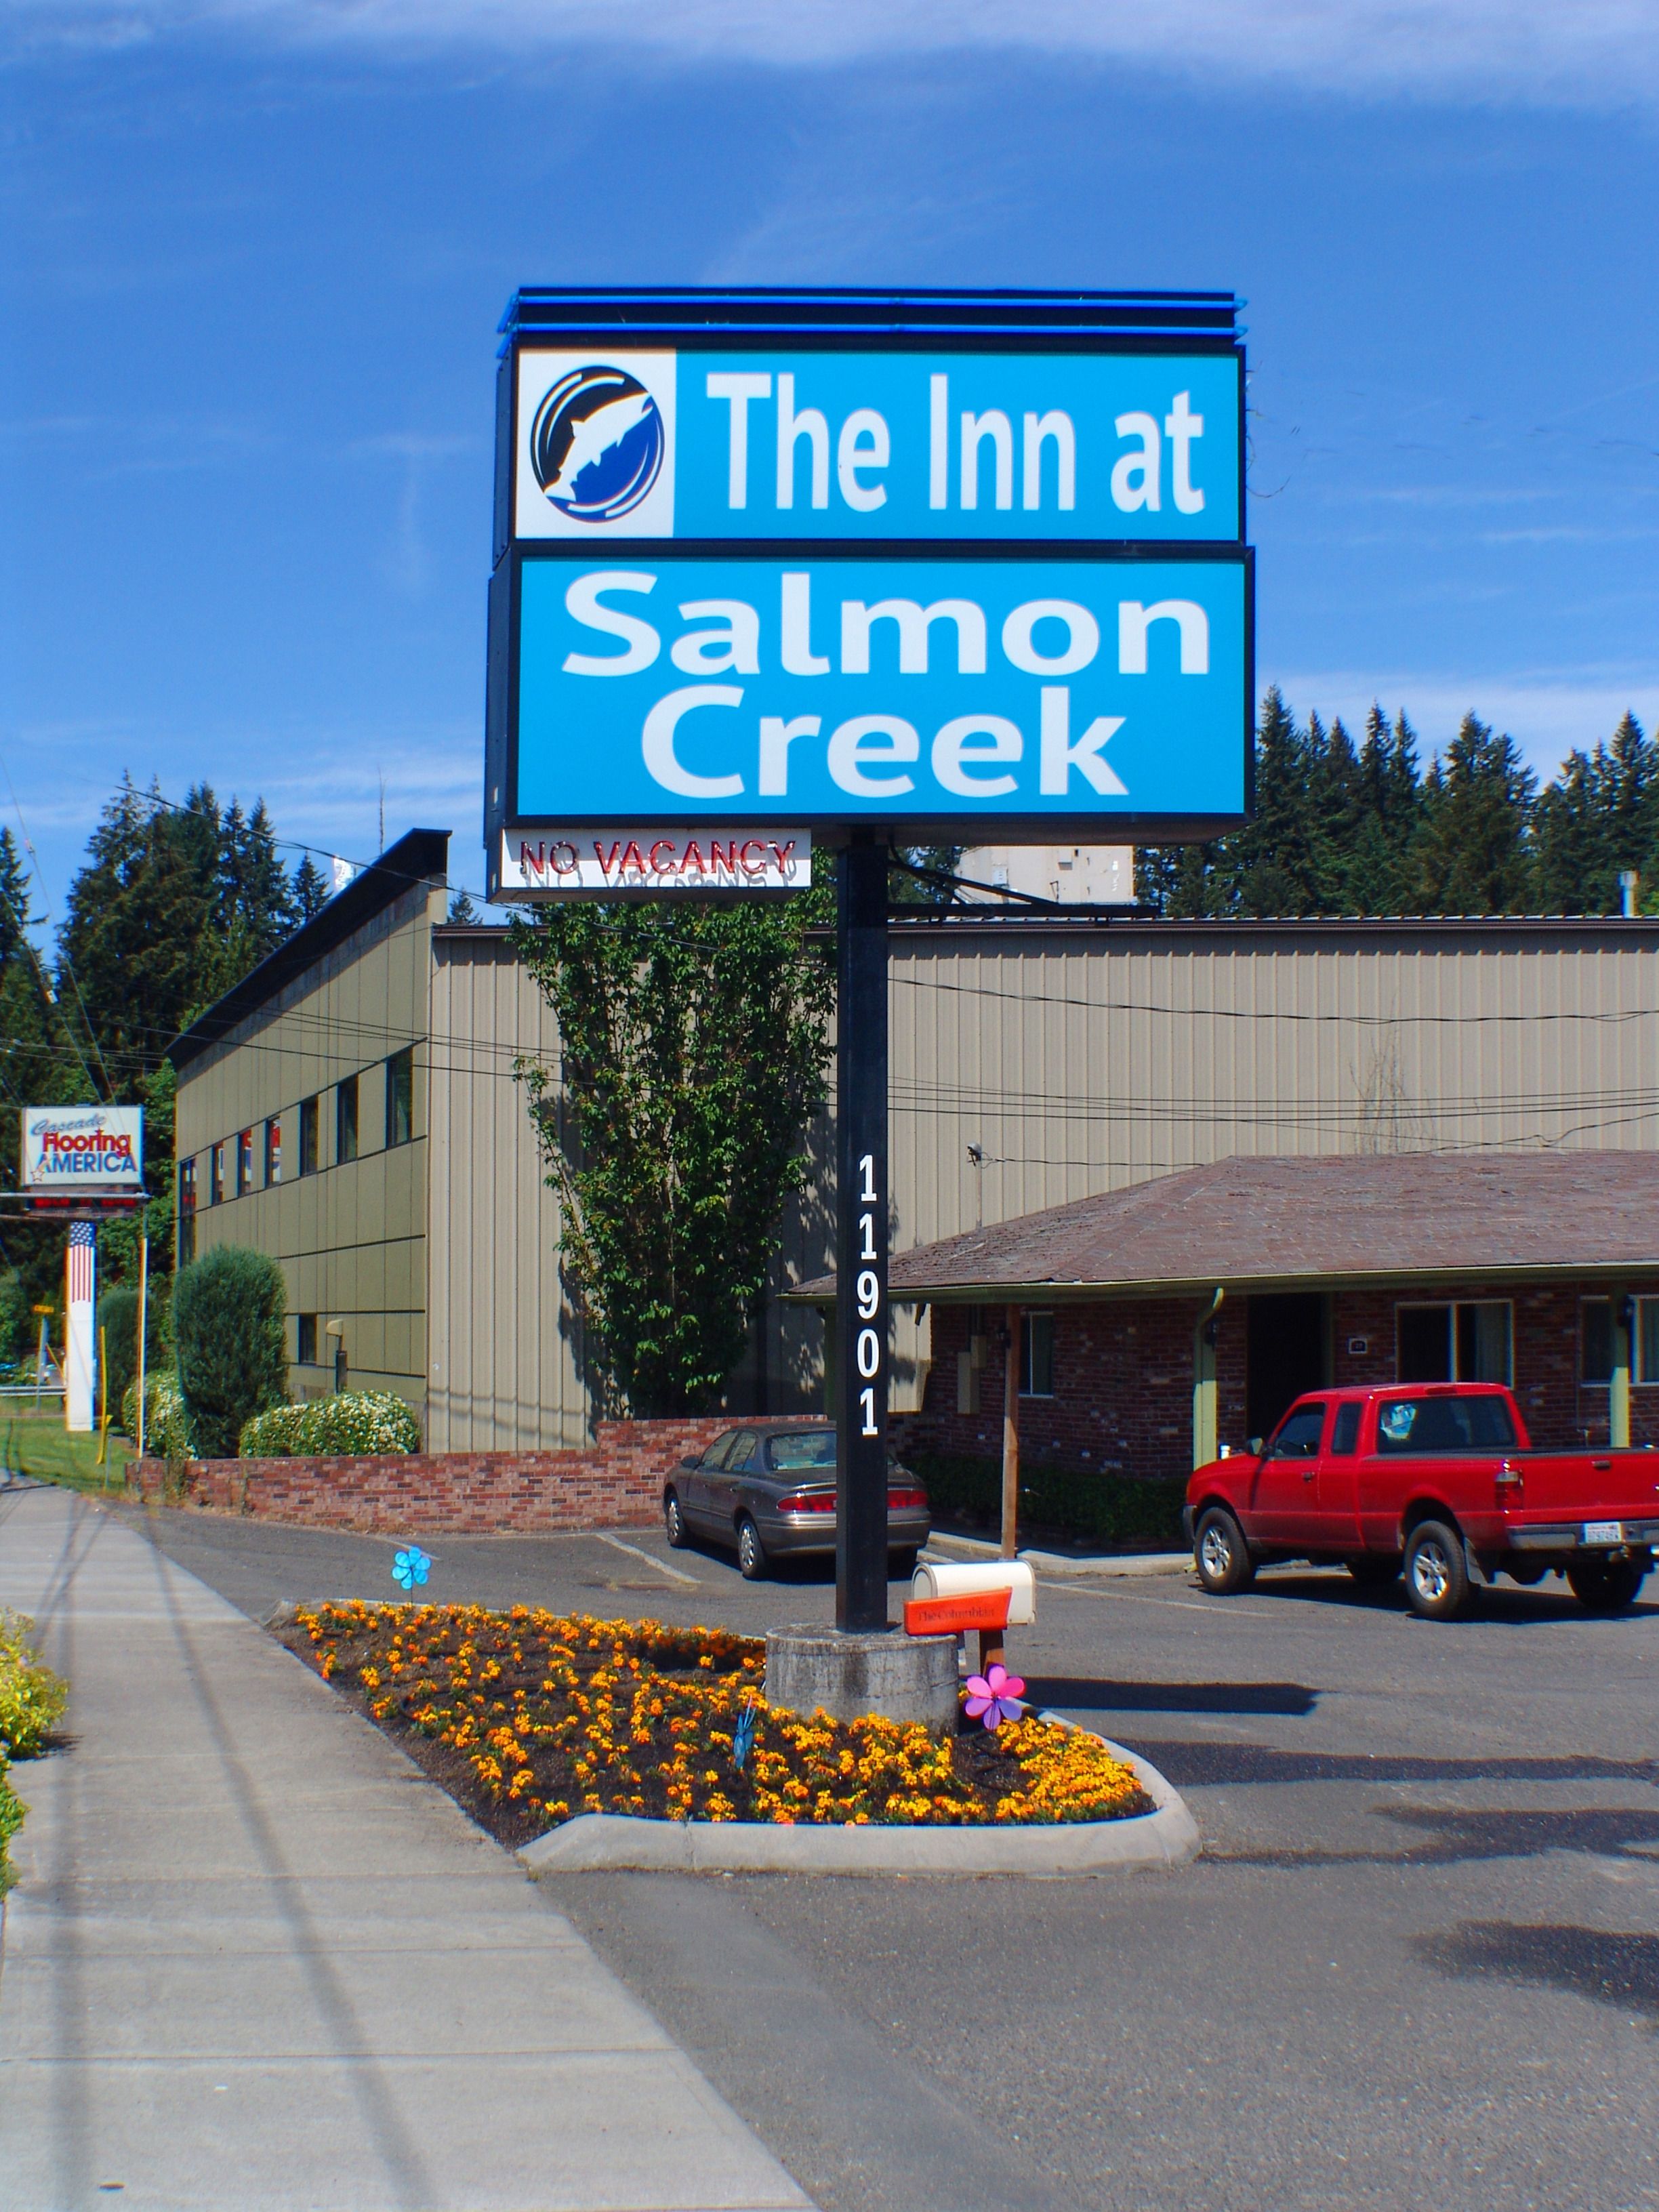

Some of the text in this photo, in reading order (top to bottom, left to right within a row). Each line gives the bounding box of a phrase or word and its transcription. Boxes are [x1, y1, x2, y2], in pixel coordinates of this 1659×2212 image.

[706, 373, 1205, 513] The Inn at
[562, 570, 1209, 677] Salmon
[641, 684, 1129, 798] Creek
[520, 840, 796, 875] NO VACANCY
[31, 1113, 106, 1136] Cascade
[43, 1128, 131, 1157] Flooring
[36, 1151, 138, 1173] AMERICA
[857, 1153, 880, 1436] 11901
